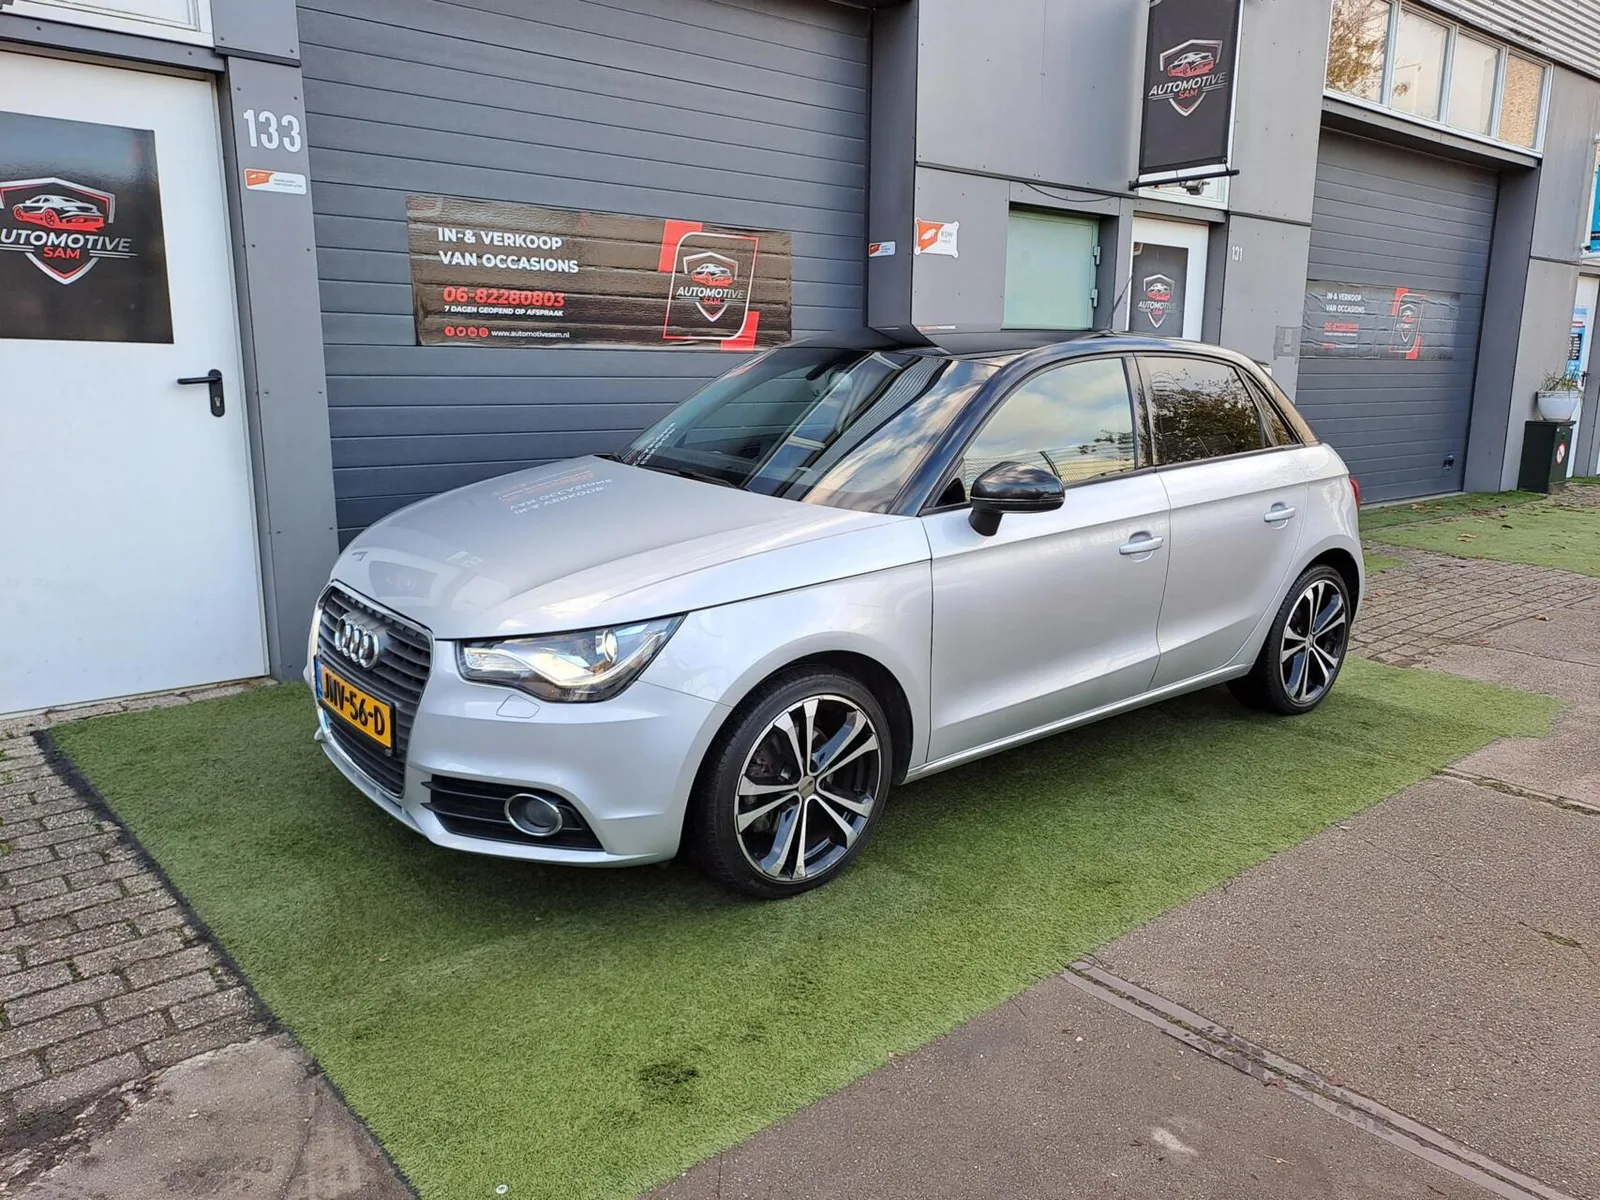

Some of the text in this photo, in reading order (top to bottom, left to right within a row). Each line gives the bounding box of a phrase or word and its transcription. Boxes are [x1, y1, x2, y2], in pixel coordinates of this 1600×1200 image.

[1148, 71, 1227, 97] AUTOMOTIVE
[1178, 89, 1198, 99] SAM
[243, 109, 302, 153] 133
[0, 228, 132, 252] UTOMOTIVE
[437, 227, 563, 250] IN-& VERKOOP
[43, 246, 81, 260] SAM
[438, 250, 579, 273] VAN OCCASIONS
[1231, 245, 1243, 262] 131
[443, 286, 565, 307] 06-82280803
[676, 286, 745, 298] AUTOMOTIVE
[478, 307, 514, 315] GEOPEND
[526, 309, 564, 317] AFSPRAAK
[491, 330, 570, 338] www.automotivesam.nl
